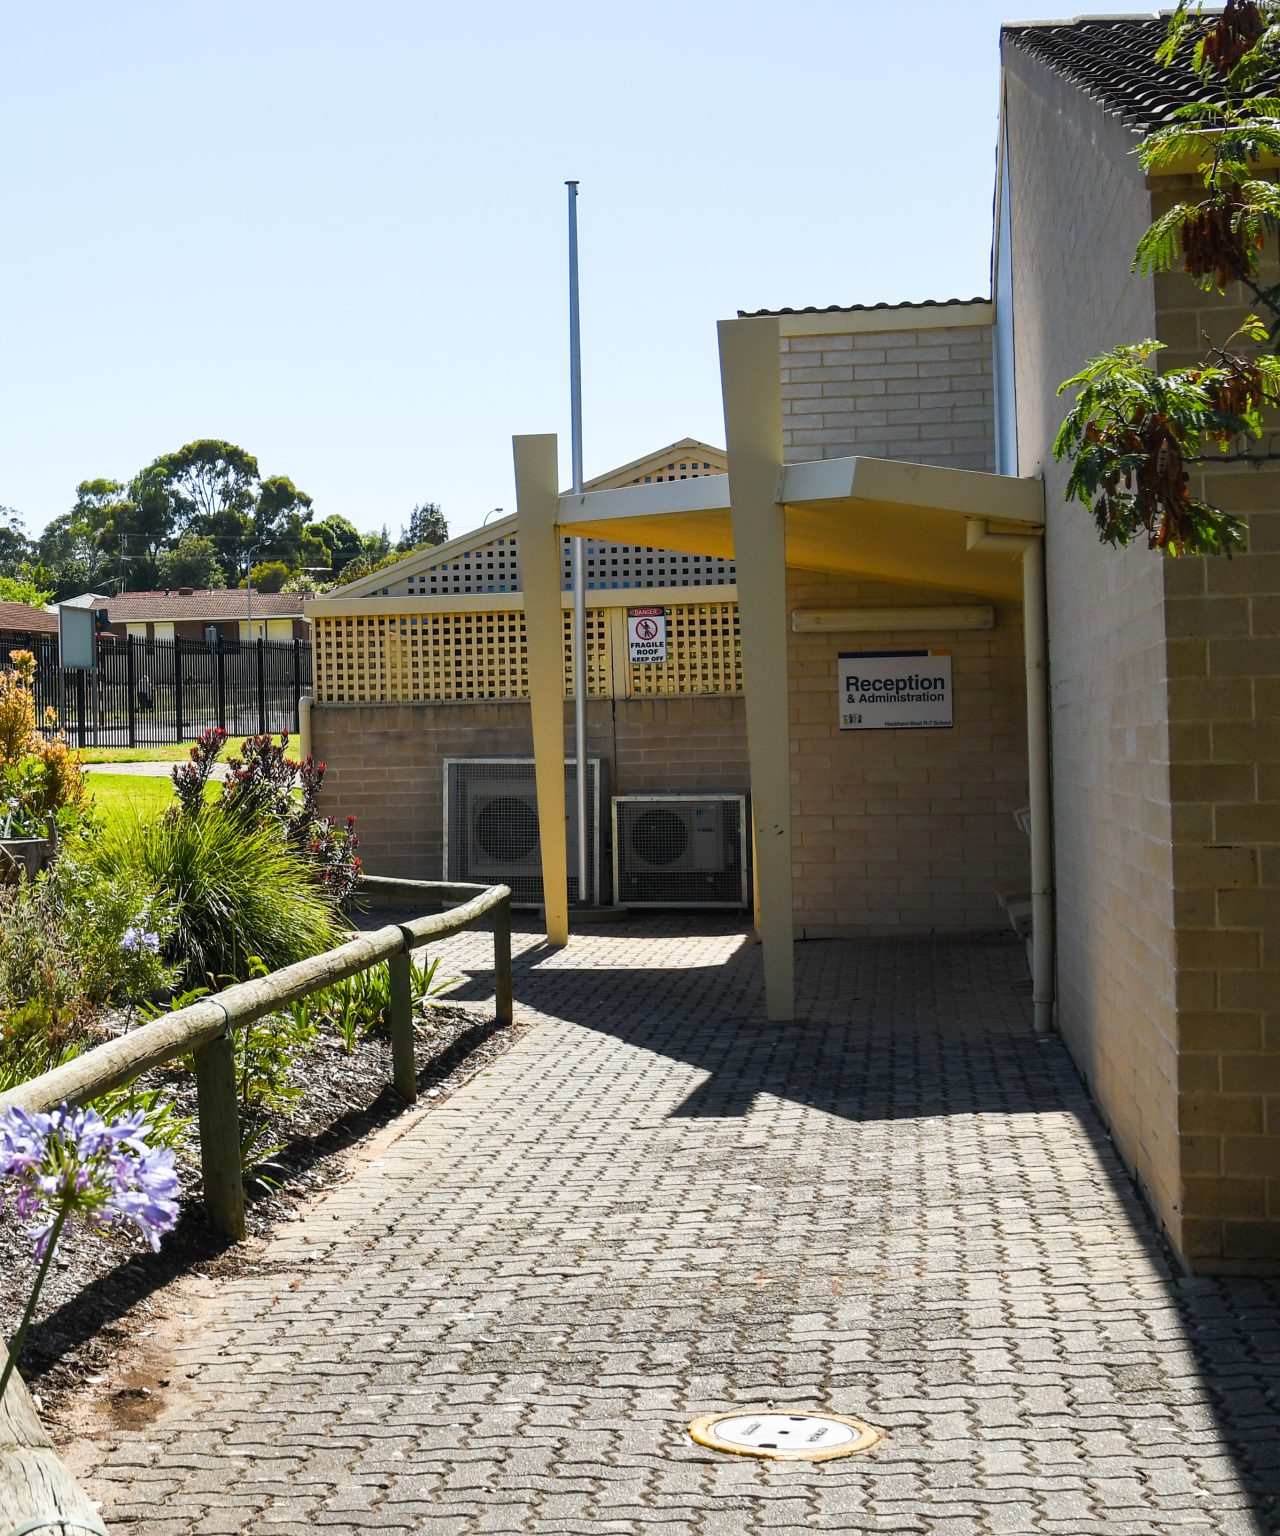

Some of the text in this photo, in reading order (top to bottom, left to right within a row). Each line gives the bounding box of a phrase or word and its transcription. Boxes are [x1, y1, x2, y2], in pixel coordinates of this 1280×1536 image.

[846, 675, 945, 694] Reception
[847, 692, 945, 703] & Administration
